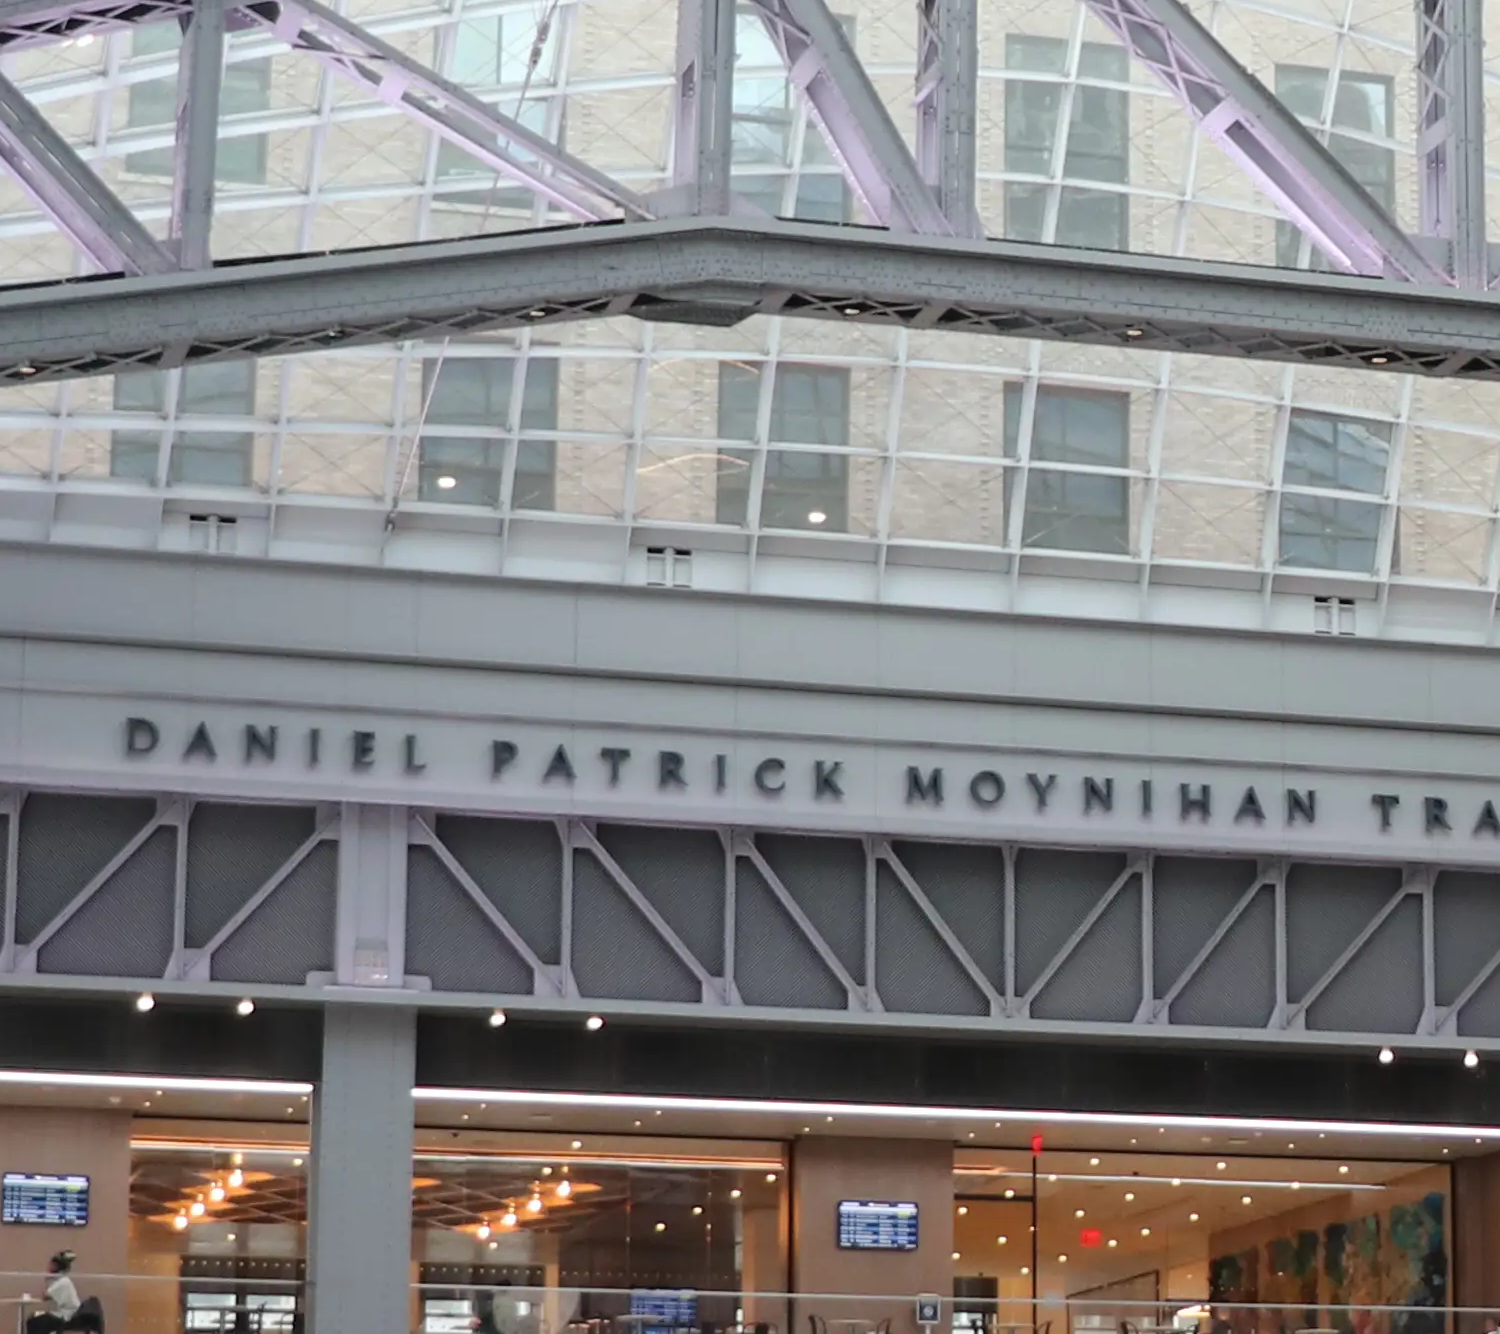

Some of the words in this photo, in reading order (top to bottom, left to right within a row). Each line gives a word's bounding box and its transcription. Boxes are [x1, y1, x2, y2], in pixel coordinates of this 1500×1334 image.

[124, 716, 428, 774] DANIEL
[490, 738, 846, 800] PATRICK
[905, 766, 1318, 825] MOYNIHAN
